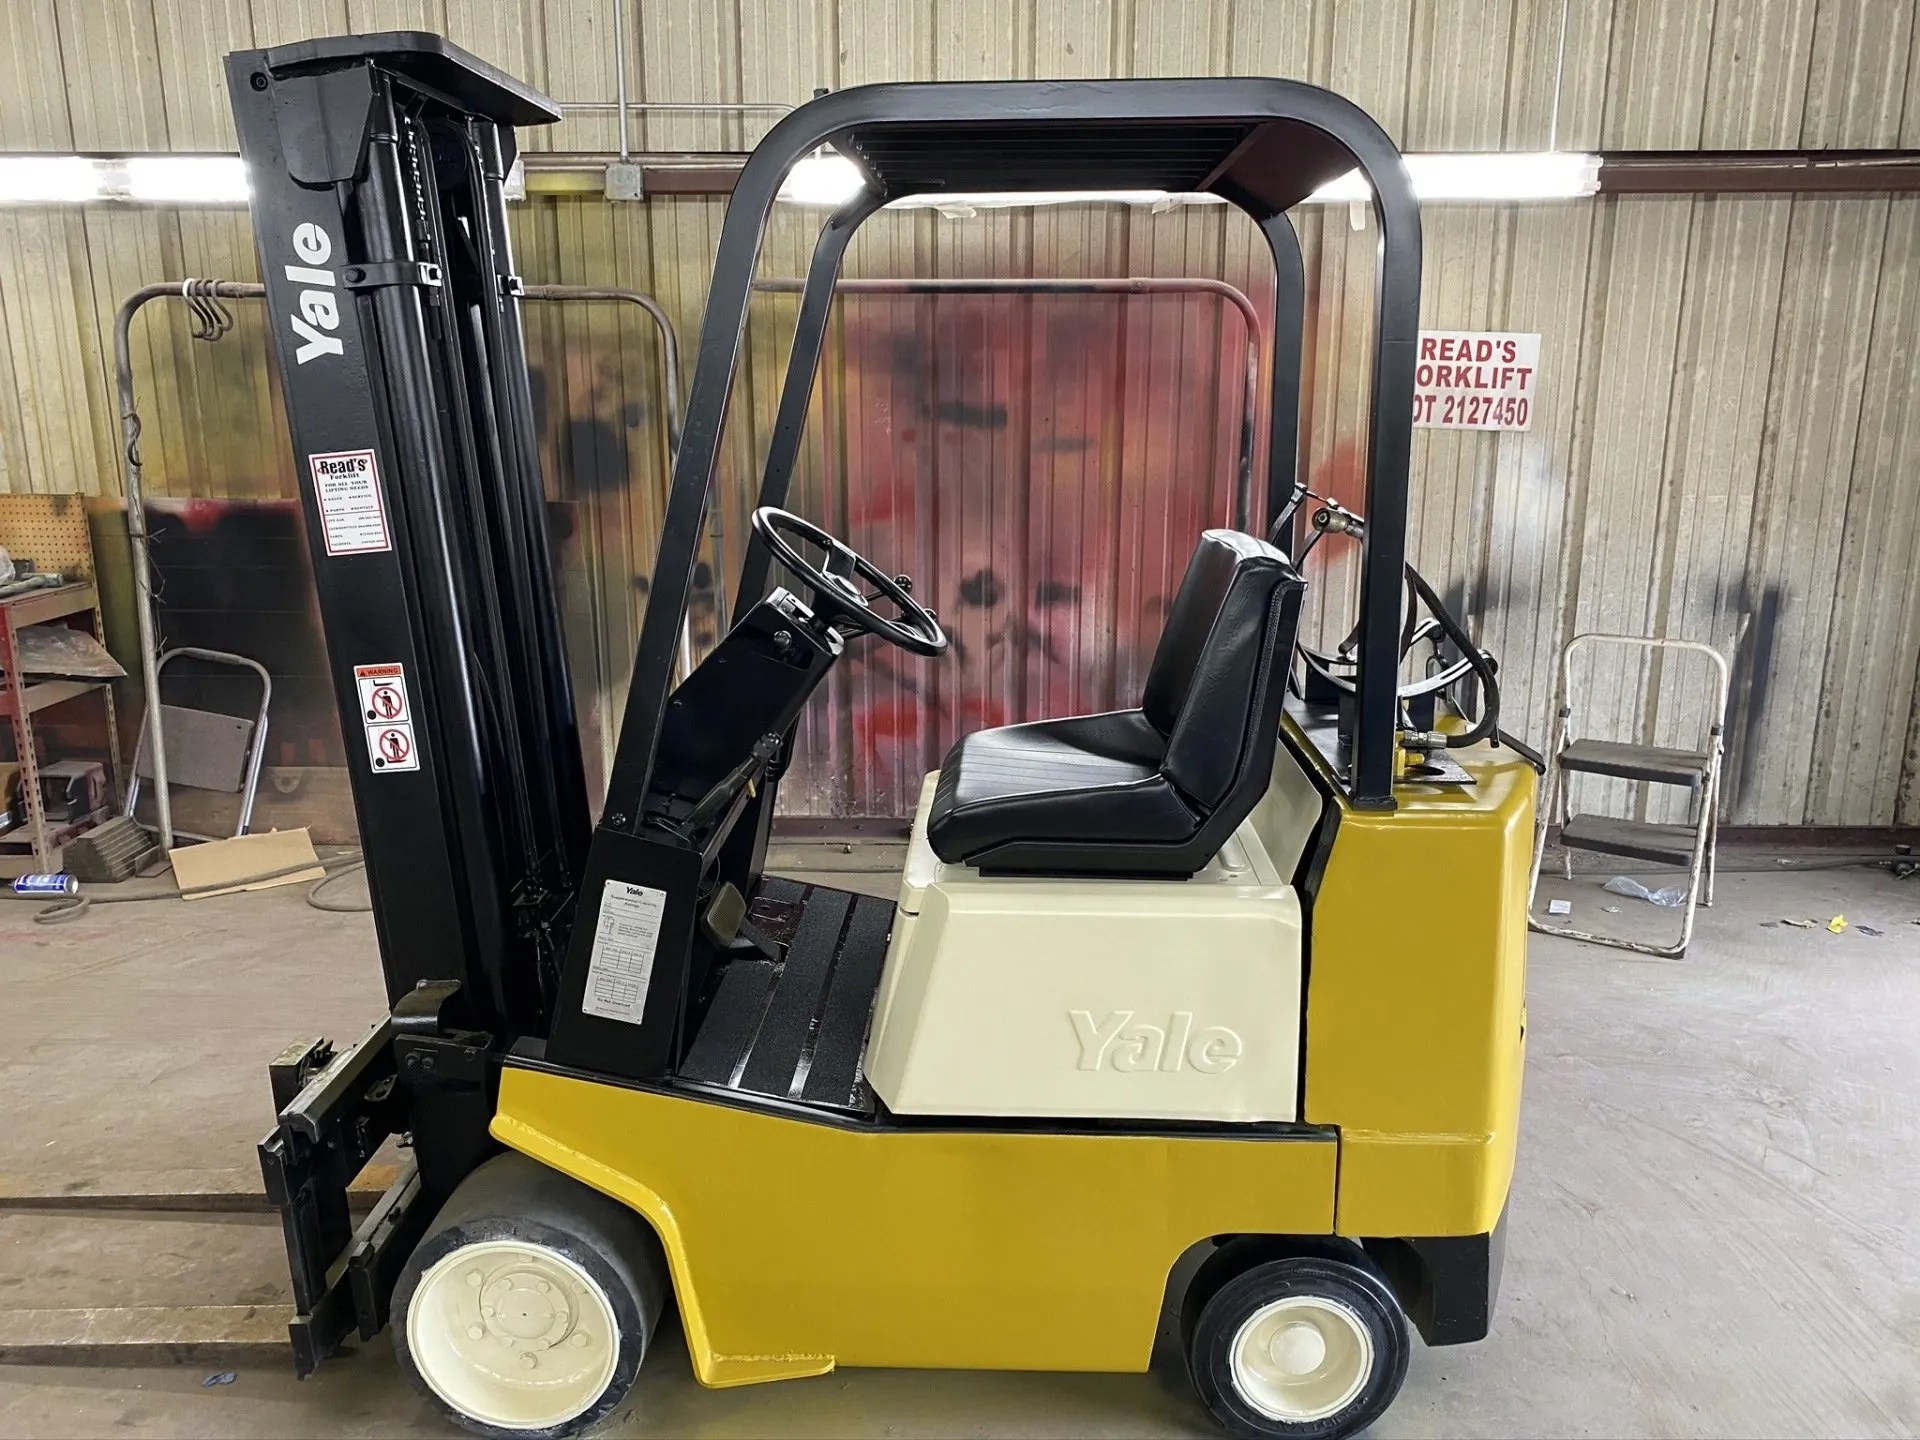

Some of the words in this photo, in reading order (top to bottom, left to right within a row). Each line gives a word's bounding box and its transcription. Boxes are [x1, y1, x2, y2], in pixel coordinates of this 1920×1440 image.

[285, 222, 344, 365] Yale
[1420, 337, 1517, 363] READ'S
[1416, 364, 1533, 390] ORKLIFT
[1442, 395, 1528, 427] 2127450
[319, 458, 367, 474] Read's
[330, 472, 360, 480] Forklift
[626, 886, 643, 896] Yale
[1068, 1010, 1242, 1074] Yale
